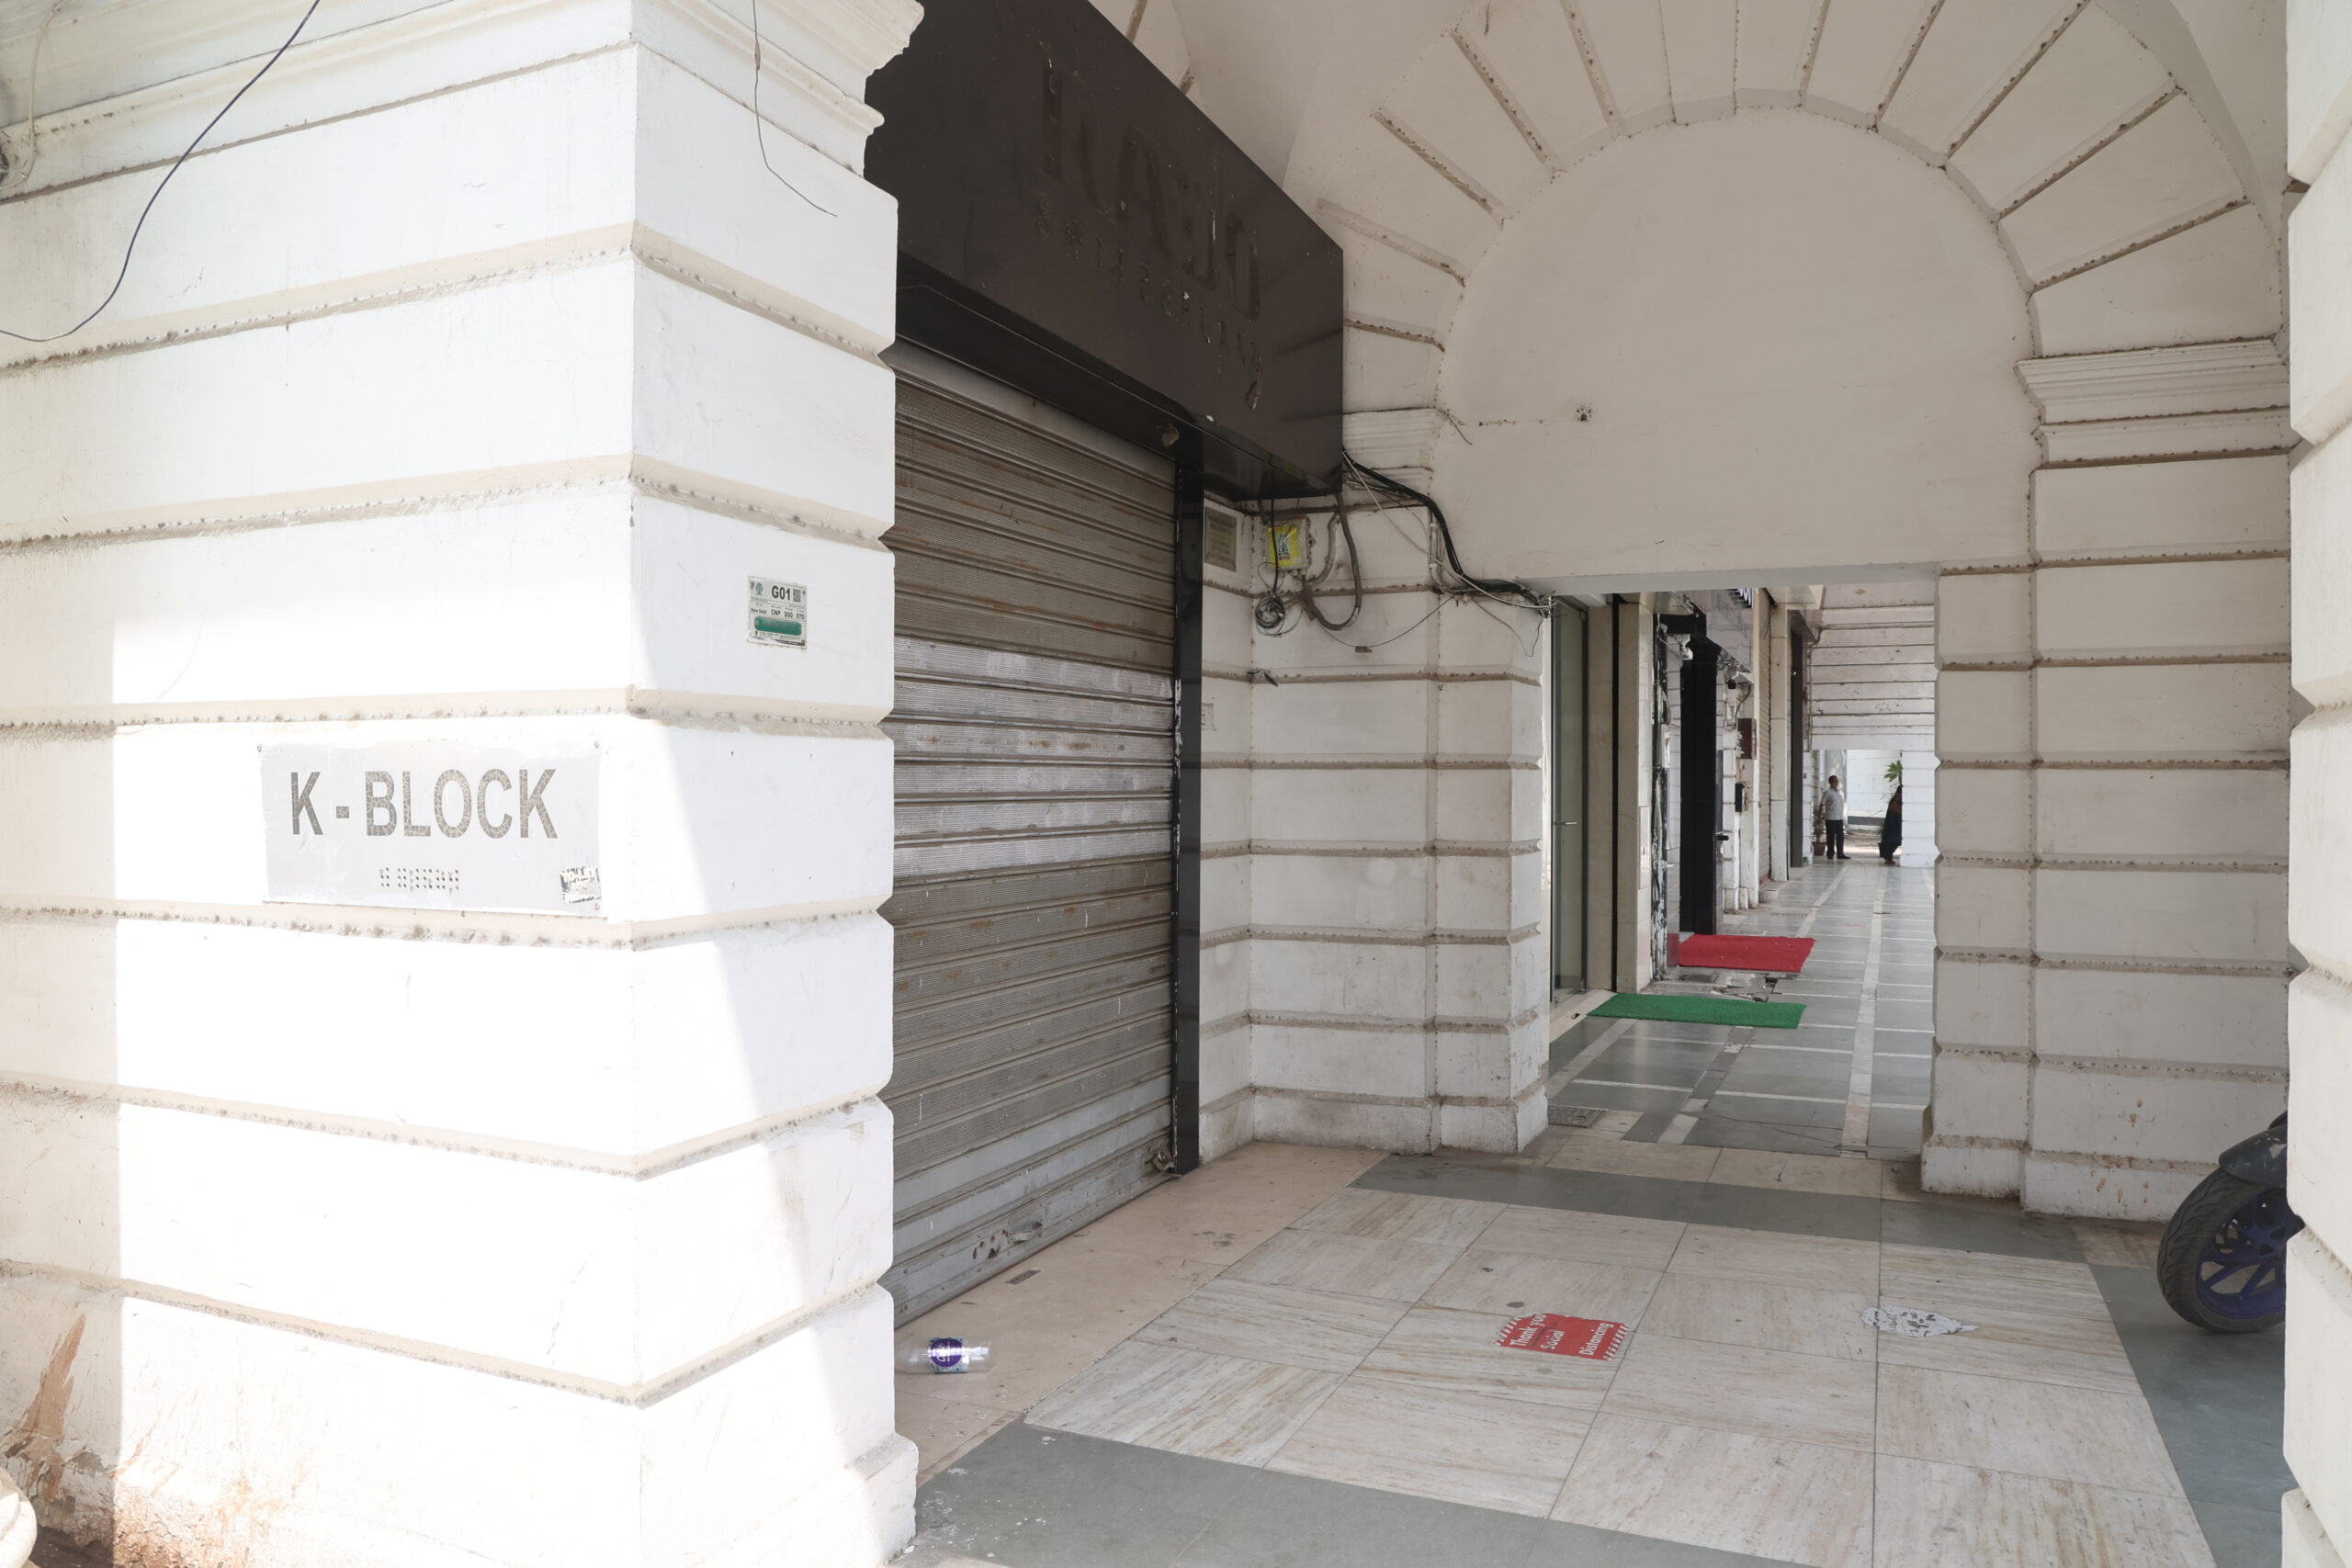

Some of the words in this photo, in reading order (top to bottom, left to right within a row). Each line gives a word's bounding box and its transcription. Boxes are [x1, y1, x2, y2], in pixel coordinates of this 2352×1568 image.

[772, 586, 790, 600] G01
[290, 772, 323, 835] K
[365, 768, 559, 839] BLOCK
[1510, 1326, 1538, 1347] Thank
[1540, 1329, 1566, 1350] Social
[1578, 1322, 1614, 1356] Distancing
